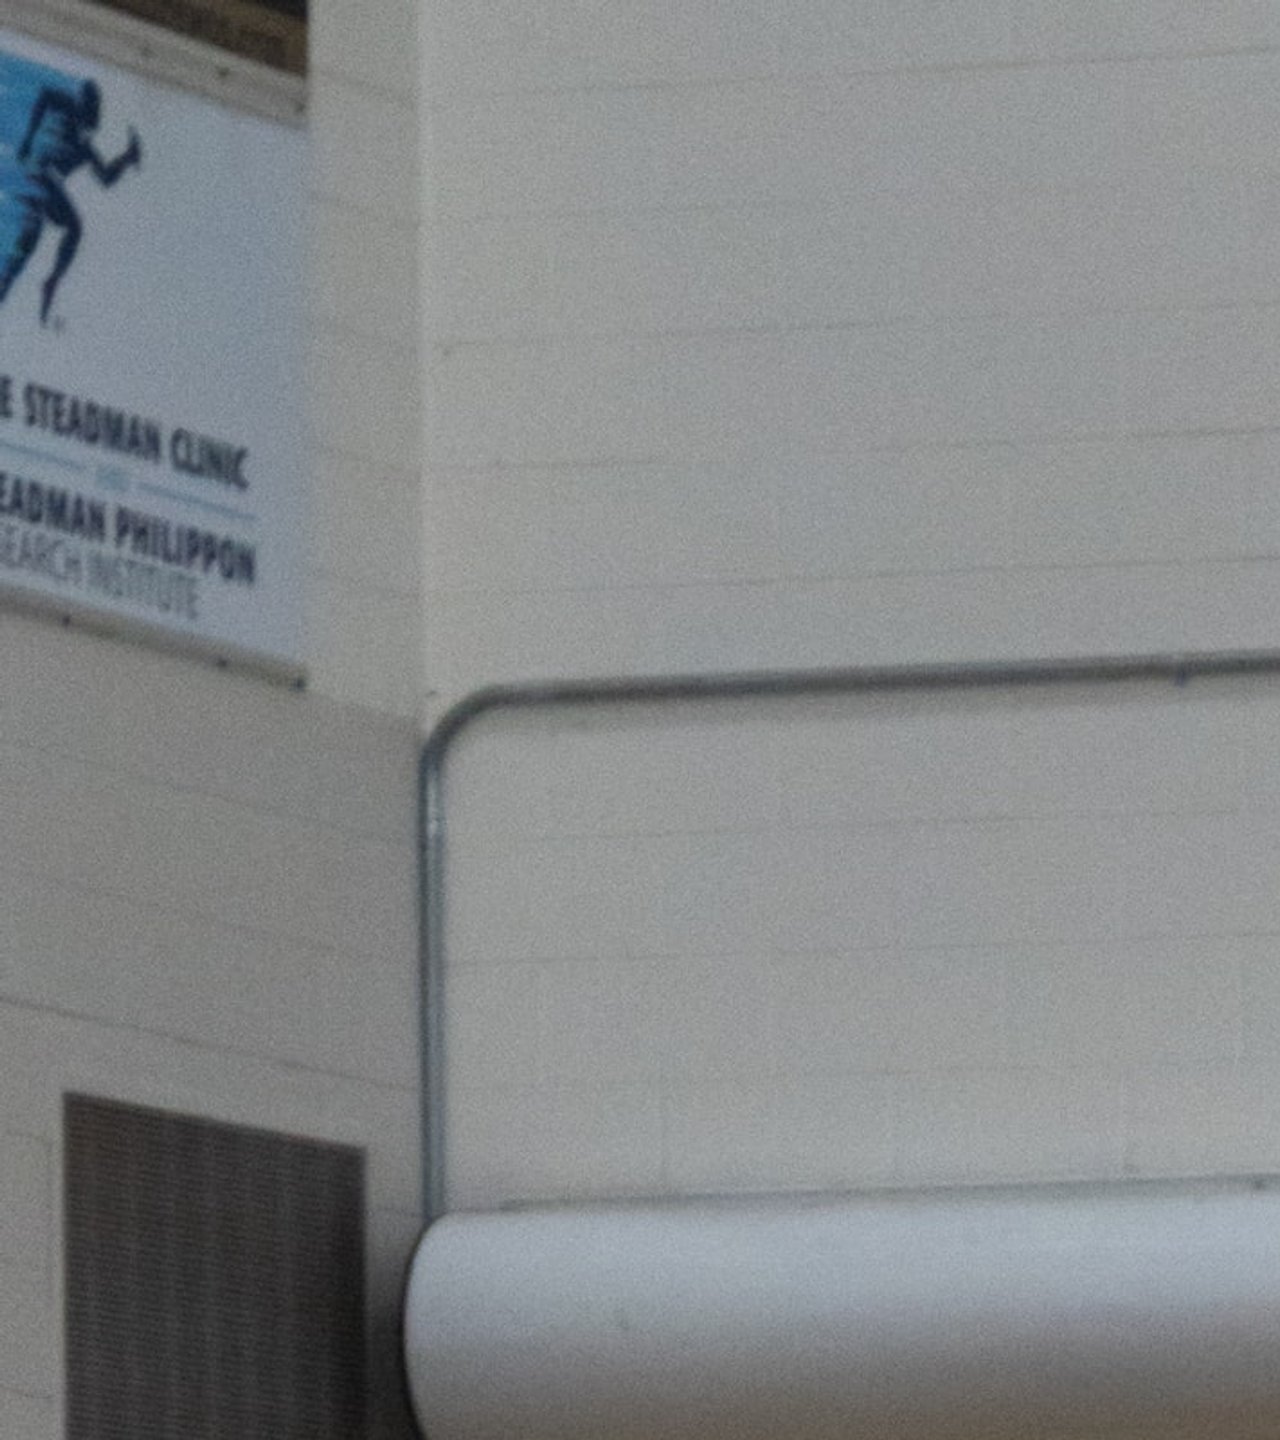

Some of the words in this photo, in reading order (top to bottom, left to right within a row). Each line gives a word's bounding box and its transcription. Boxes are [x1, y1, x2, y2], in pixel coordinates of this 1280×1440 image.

[24, 382, 161, 464] STEADMAN
[170, 427, 249, 492] CLINIC
[115, 506, 256, 585] PHILIPPON
